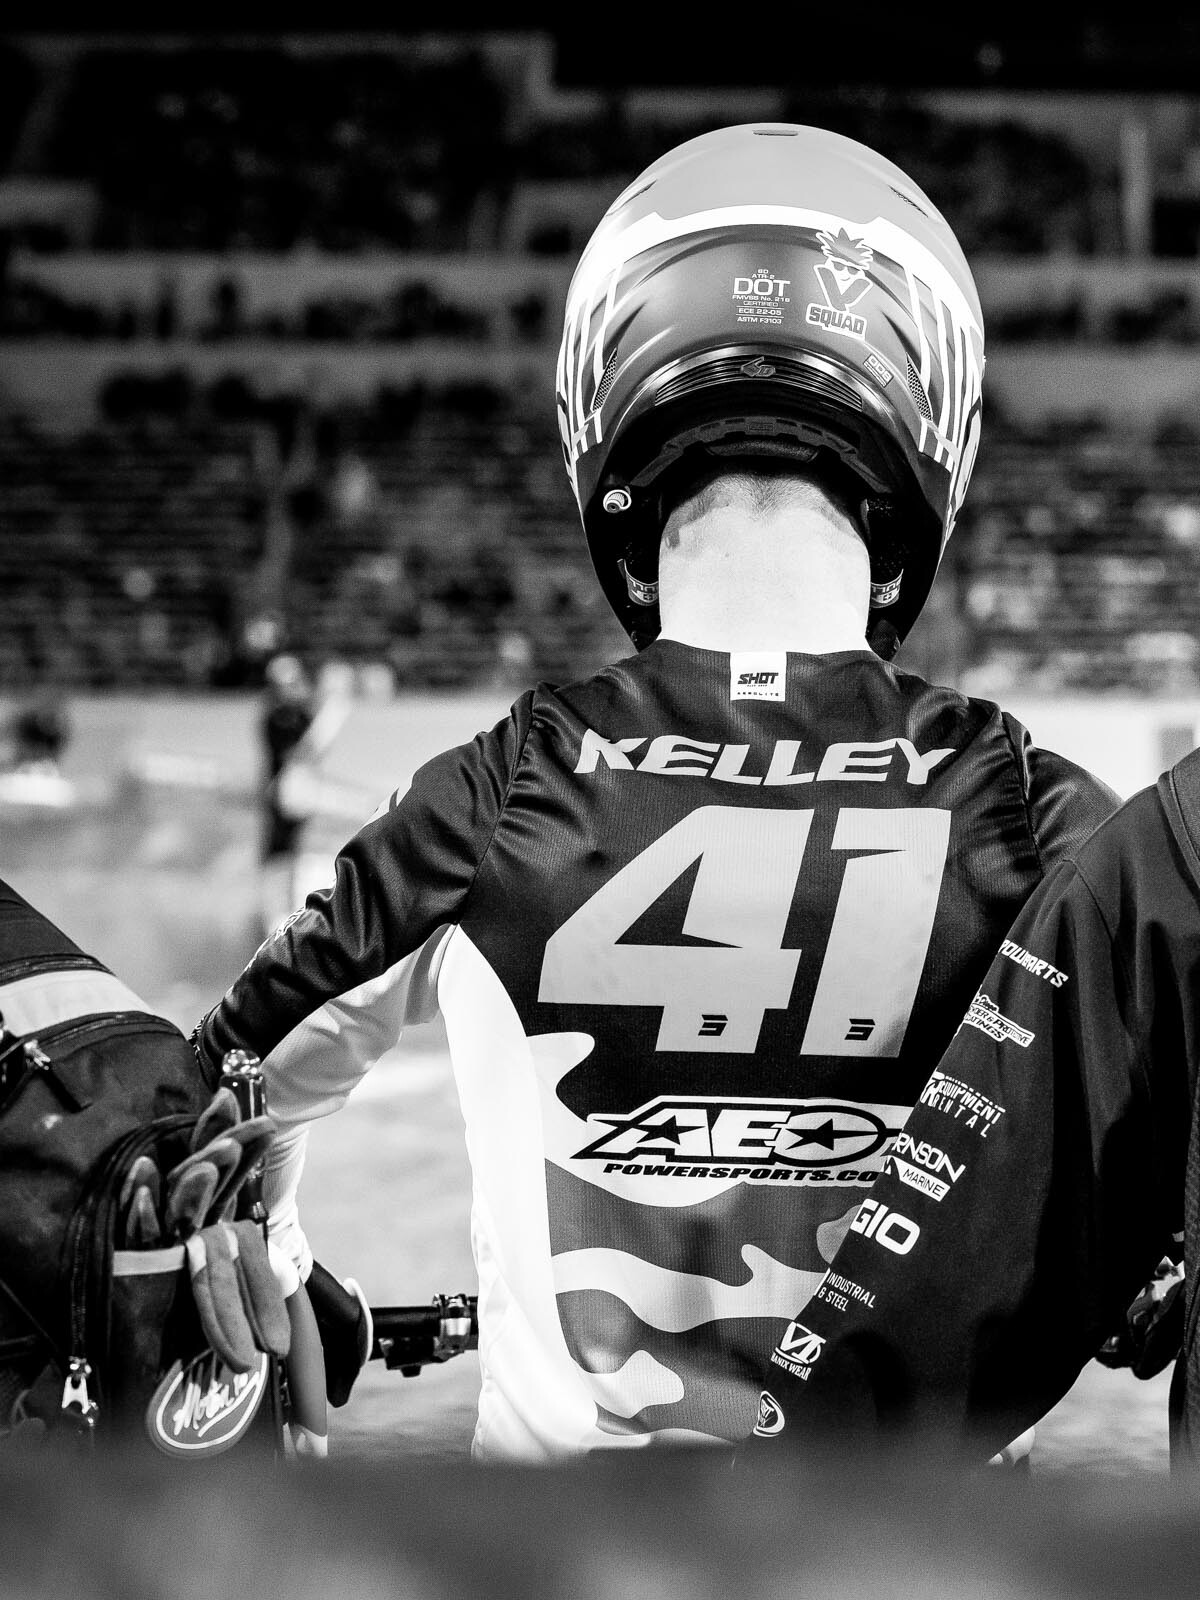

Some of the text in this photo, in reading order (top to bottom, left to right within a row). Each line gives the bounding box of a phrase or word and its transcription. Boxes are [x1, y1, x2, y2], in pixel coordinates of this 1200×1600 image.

[733, 277, 791, 296] DOT
[808, 306, 866, 335] SQUAD
[737, 671, 779, 685] SHOT
[573, 728, 956, 786] KELLEY
[537, 804, 952, 1058] 41
[902, 1168, 945, 1198] MARINE
[817, 1286, 849, 1312] & STEEL
[826, 1271, 877, 1309] INDUSTRIAL
[788, 1362, 812, 1382] WEAR
